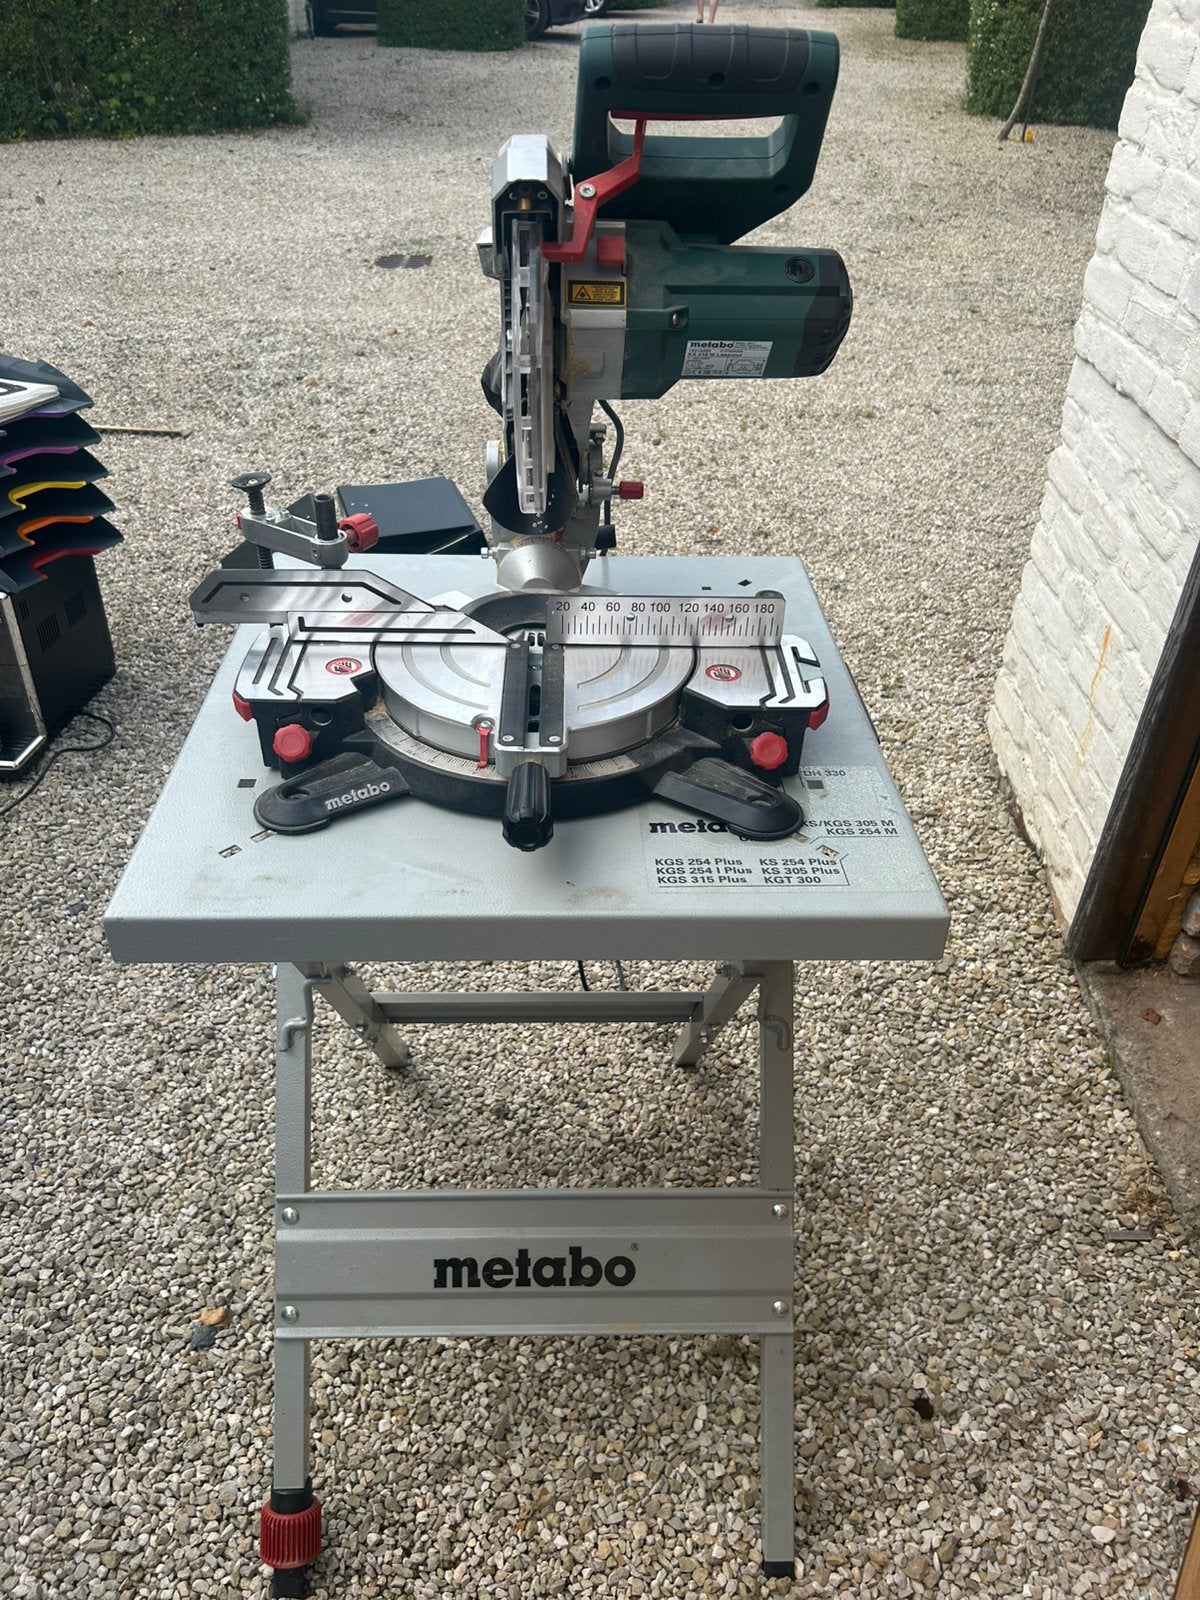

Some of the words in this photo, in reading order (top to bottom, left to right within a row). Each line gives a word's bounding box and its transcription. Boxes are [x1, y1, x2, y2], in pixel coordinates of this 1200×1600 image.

[690, 341, 735, 349] metabo
[556, 601, 570, 612] 20
[581, 601, 596, 612] 40
[606, 602, 621, 612] 60
[631, 602, 646, 613] 80
[650, 602, 671, 613] 100
[679, 603, 700, 613] 120
[704, 603, 725, 613] 140
[729, 603, 750, 614] 160
[754, 603, 775, 614] 180
[824, 769, 846, 777] 330
[324, 781, 392, 811] metabo
[649, 819, 729, 834] meta
[854, 819, 878, 828] 305
[881, 819, 895, 828] M
[826, 828, 855, 836] KGS
[858, 828, 881, 836] 254
[885, 828, 899, 836] M
[655, 858, 684, 866] KGS
[687, 858, 711, 866] 254
[715, 858, 743, 866] Plus
[759, 858, 778, 866] KS
[781, 858, 805, 866] 254
[808, 858, 837, 866] Plus
[656, 867, 686, 875] KGS
[689, 867, 713, 875] 254
[724, 866, 753, 875] Plus
[761, 867, 780, 875] KS
[784, 867, 808, 875] 305
[811, 867, 840, 875] Plus
[657, 876, 687, 884] KGS
[691, 876, 715, 884] 315
[718, 876, 748, 884] Plus
[763, 876, 792, 884] KGT
[796, 876, 822, 884] 300
[434, 1246, 636, 1288] metabo
